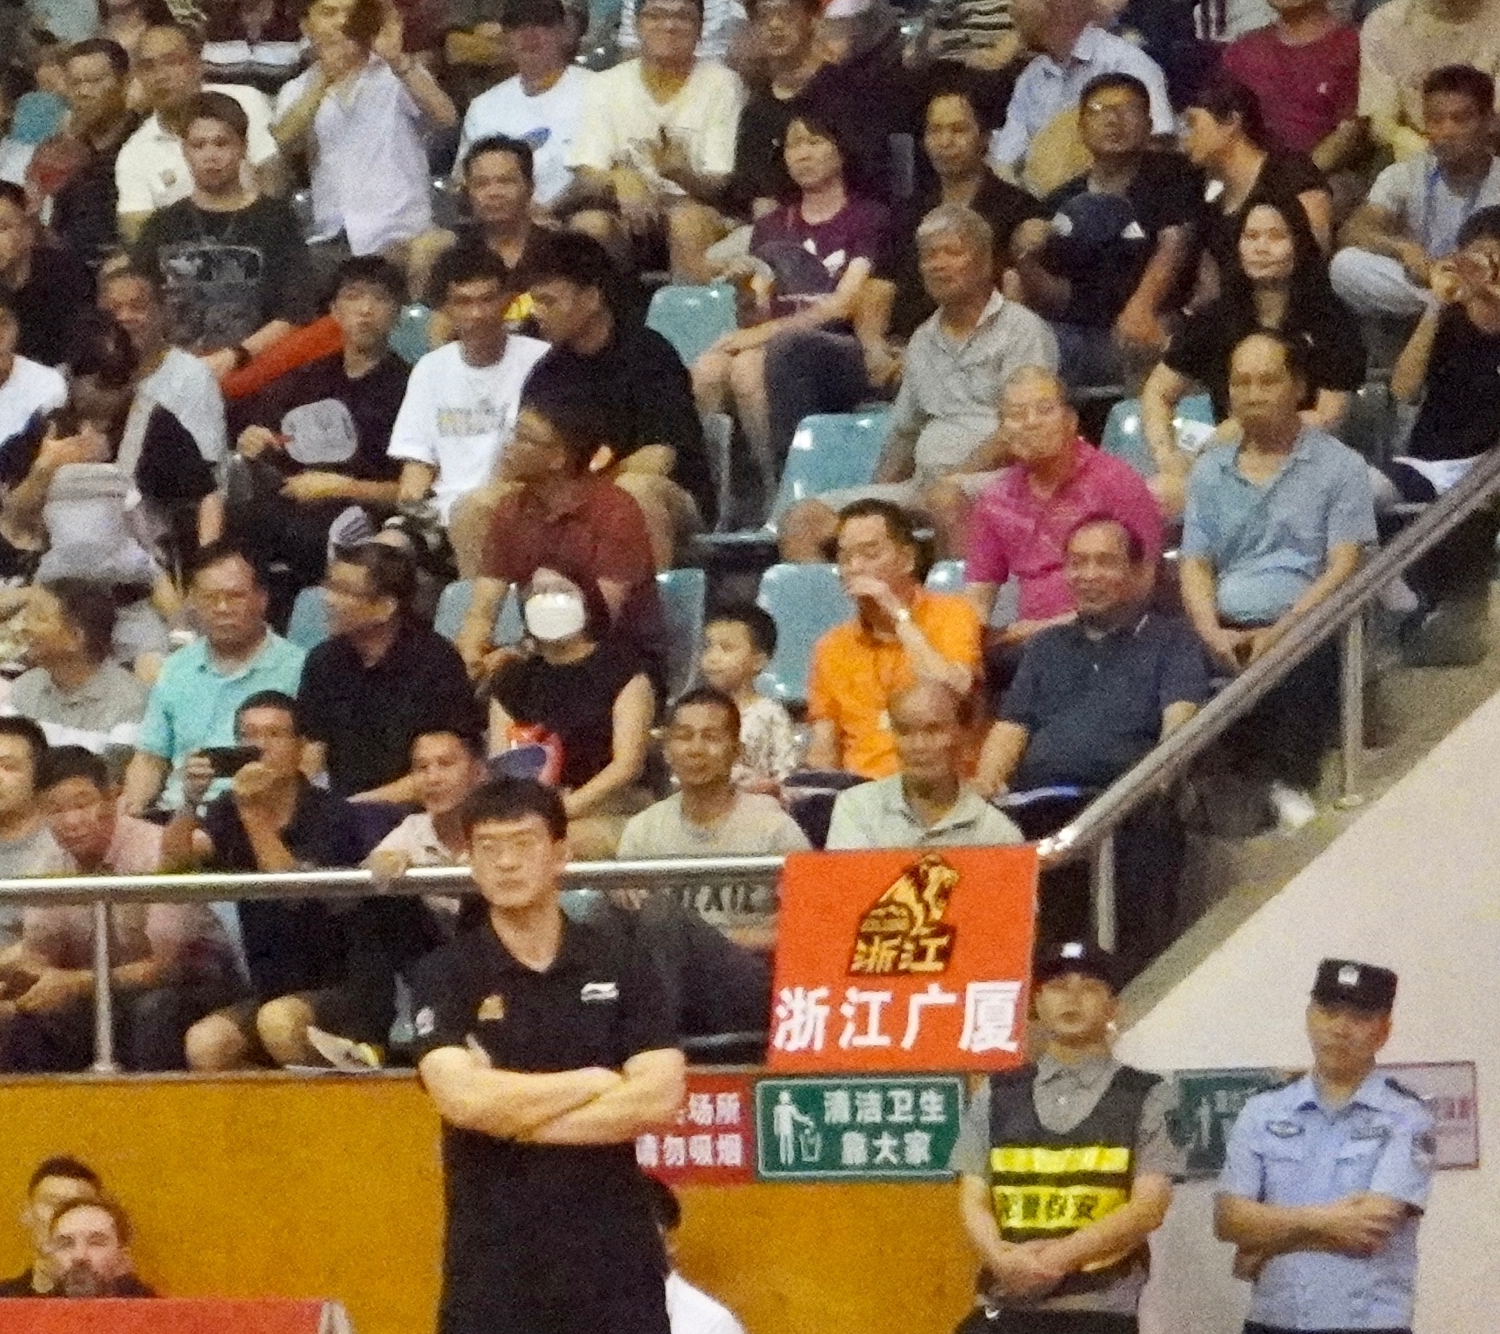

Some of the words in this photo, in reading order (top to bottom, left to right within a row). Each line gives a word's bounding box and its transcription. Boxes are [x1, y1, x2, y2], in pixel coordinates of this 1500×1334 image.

[849, 934, 951, 973] 浙江
[774, 977, 1024, 1055] 浙江广厦
[676, 1091, 742, 1126] 场所
[823, 1088, 949, 1126] 清洁卫生
[635, 1133, 744, 1168] 请勿吸烟
[840, 1130, 932, 1167] 靠大家
